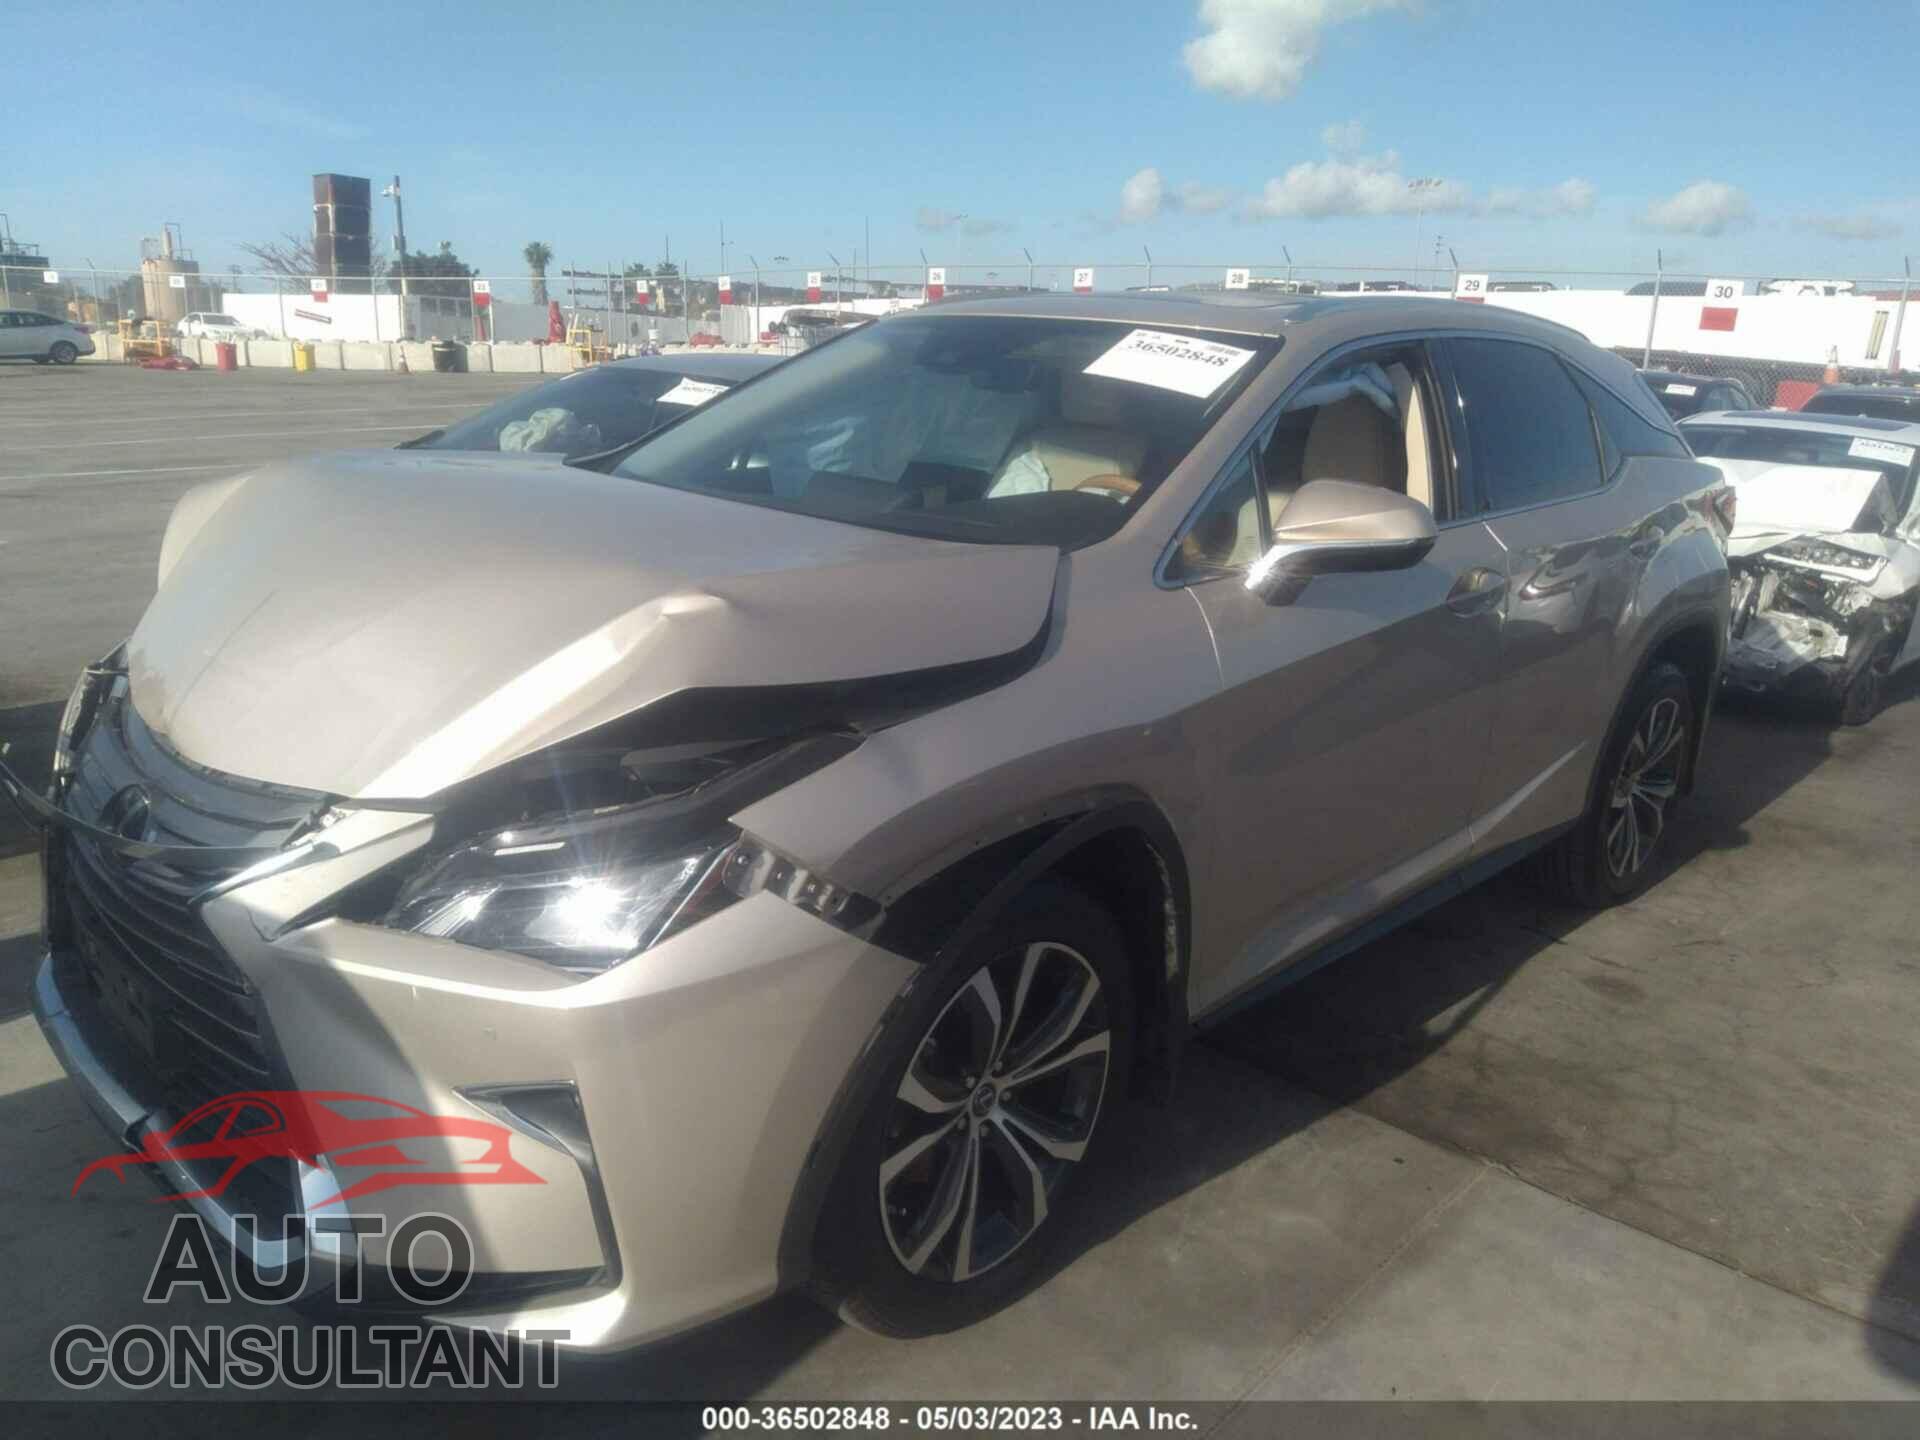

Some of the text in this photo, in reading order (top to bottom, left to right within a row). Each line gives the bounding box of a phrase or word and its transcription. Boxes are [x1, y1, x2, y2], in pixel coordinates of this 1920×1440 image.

[1077, 272, 1088, 283] 27
[1231, 272, 1244, 285] 28
[1464, 279, 1480, 292] 29
[1714, 286, 1734, 299] 30
[1128, 339, 1229, 367] 36502848
